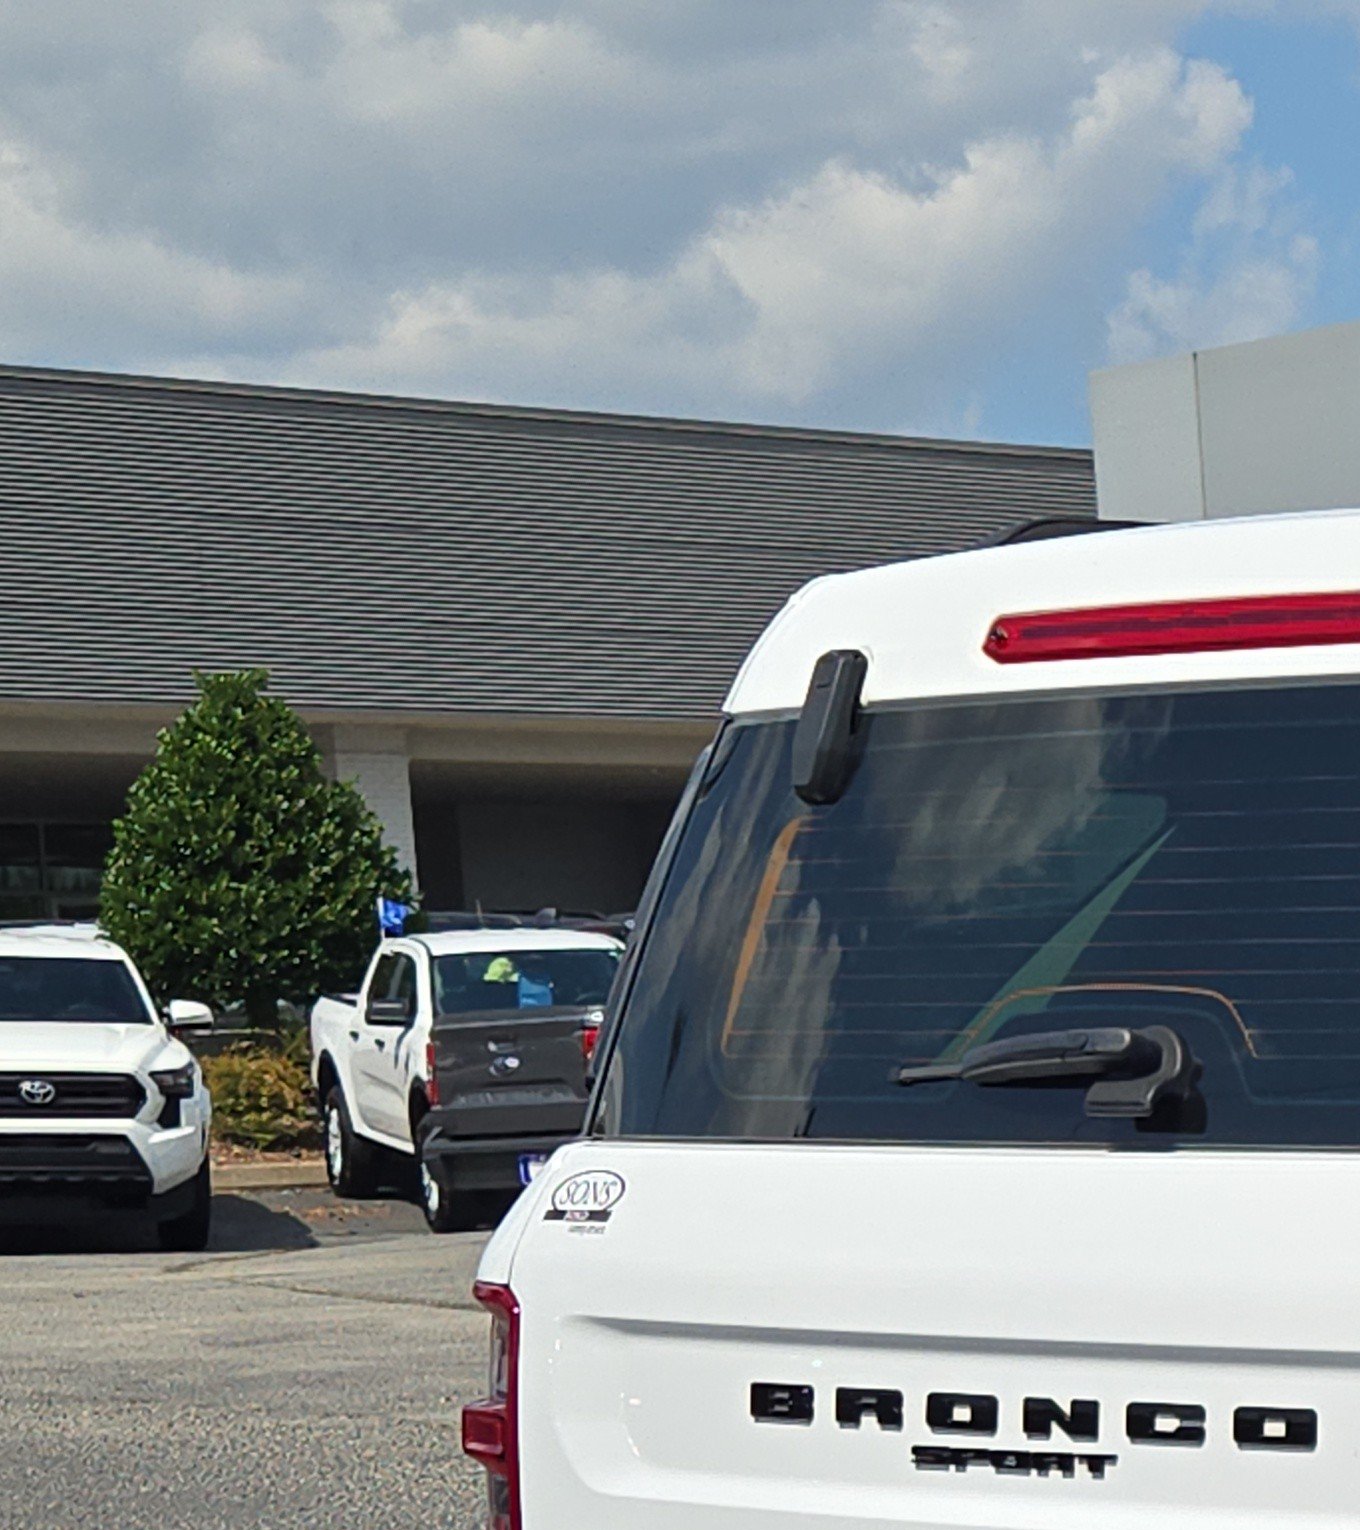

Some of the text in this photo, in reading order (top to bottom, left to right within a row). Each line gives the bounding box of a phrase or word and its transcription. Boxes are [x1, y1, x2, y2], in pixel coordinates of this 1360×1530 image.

[558, 1179, 618, 1206] SONS
[749, 1381, 1320, 1454] BRONCO
[910, 1444, 1119, 1481] SPORT
